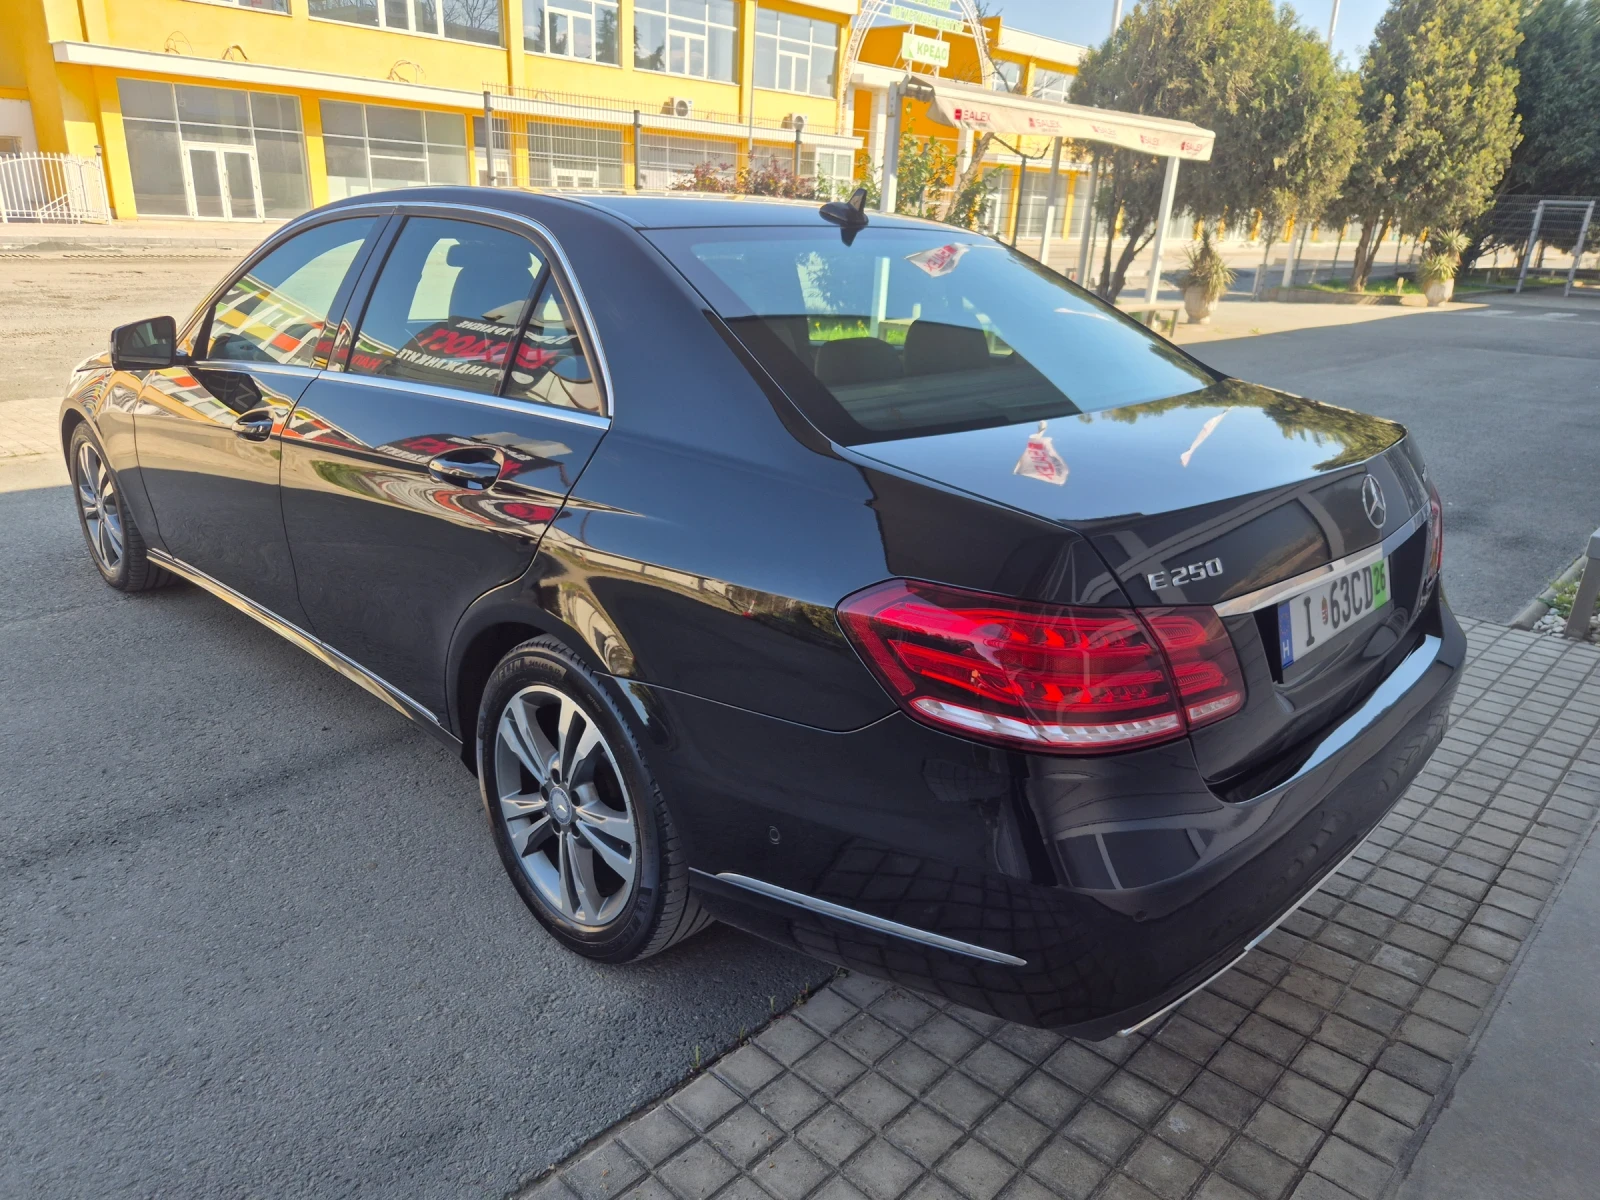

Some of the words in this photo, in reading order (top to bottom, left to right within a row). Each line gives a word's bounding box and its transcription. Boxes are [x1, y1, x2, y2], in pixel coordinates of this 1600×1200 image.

[916, 41, 948, 61] КРЕДО
[963, 109, 991, 122] SALEX
[1035, 118, 1061, 129] SALEX
[1147, 570, 1168, 591] E
[1170, 557, 1223, 587] 250
[1303, 596, 1315, 647] I
[1330, 565, 1374, 630] 63CD
[1374, 563, 1386, 595] 26
[1282, 639, 1290, 659] H
